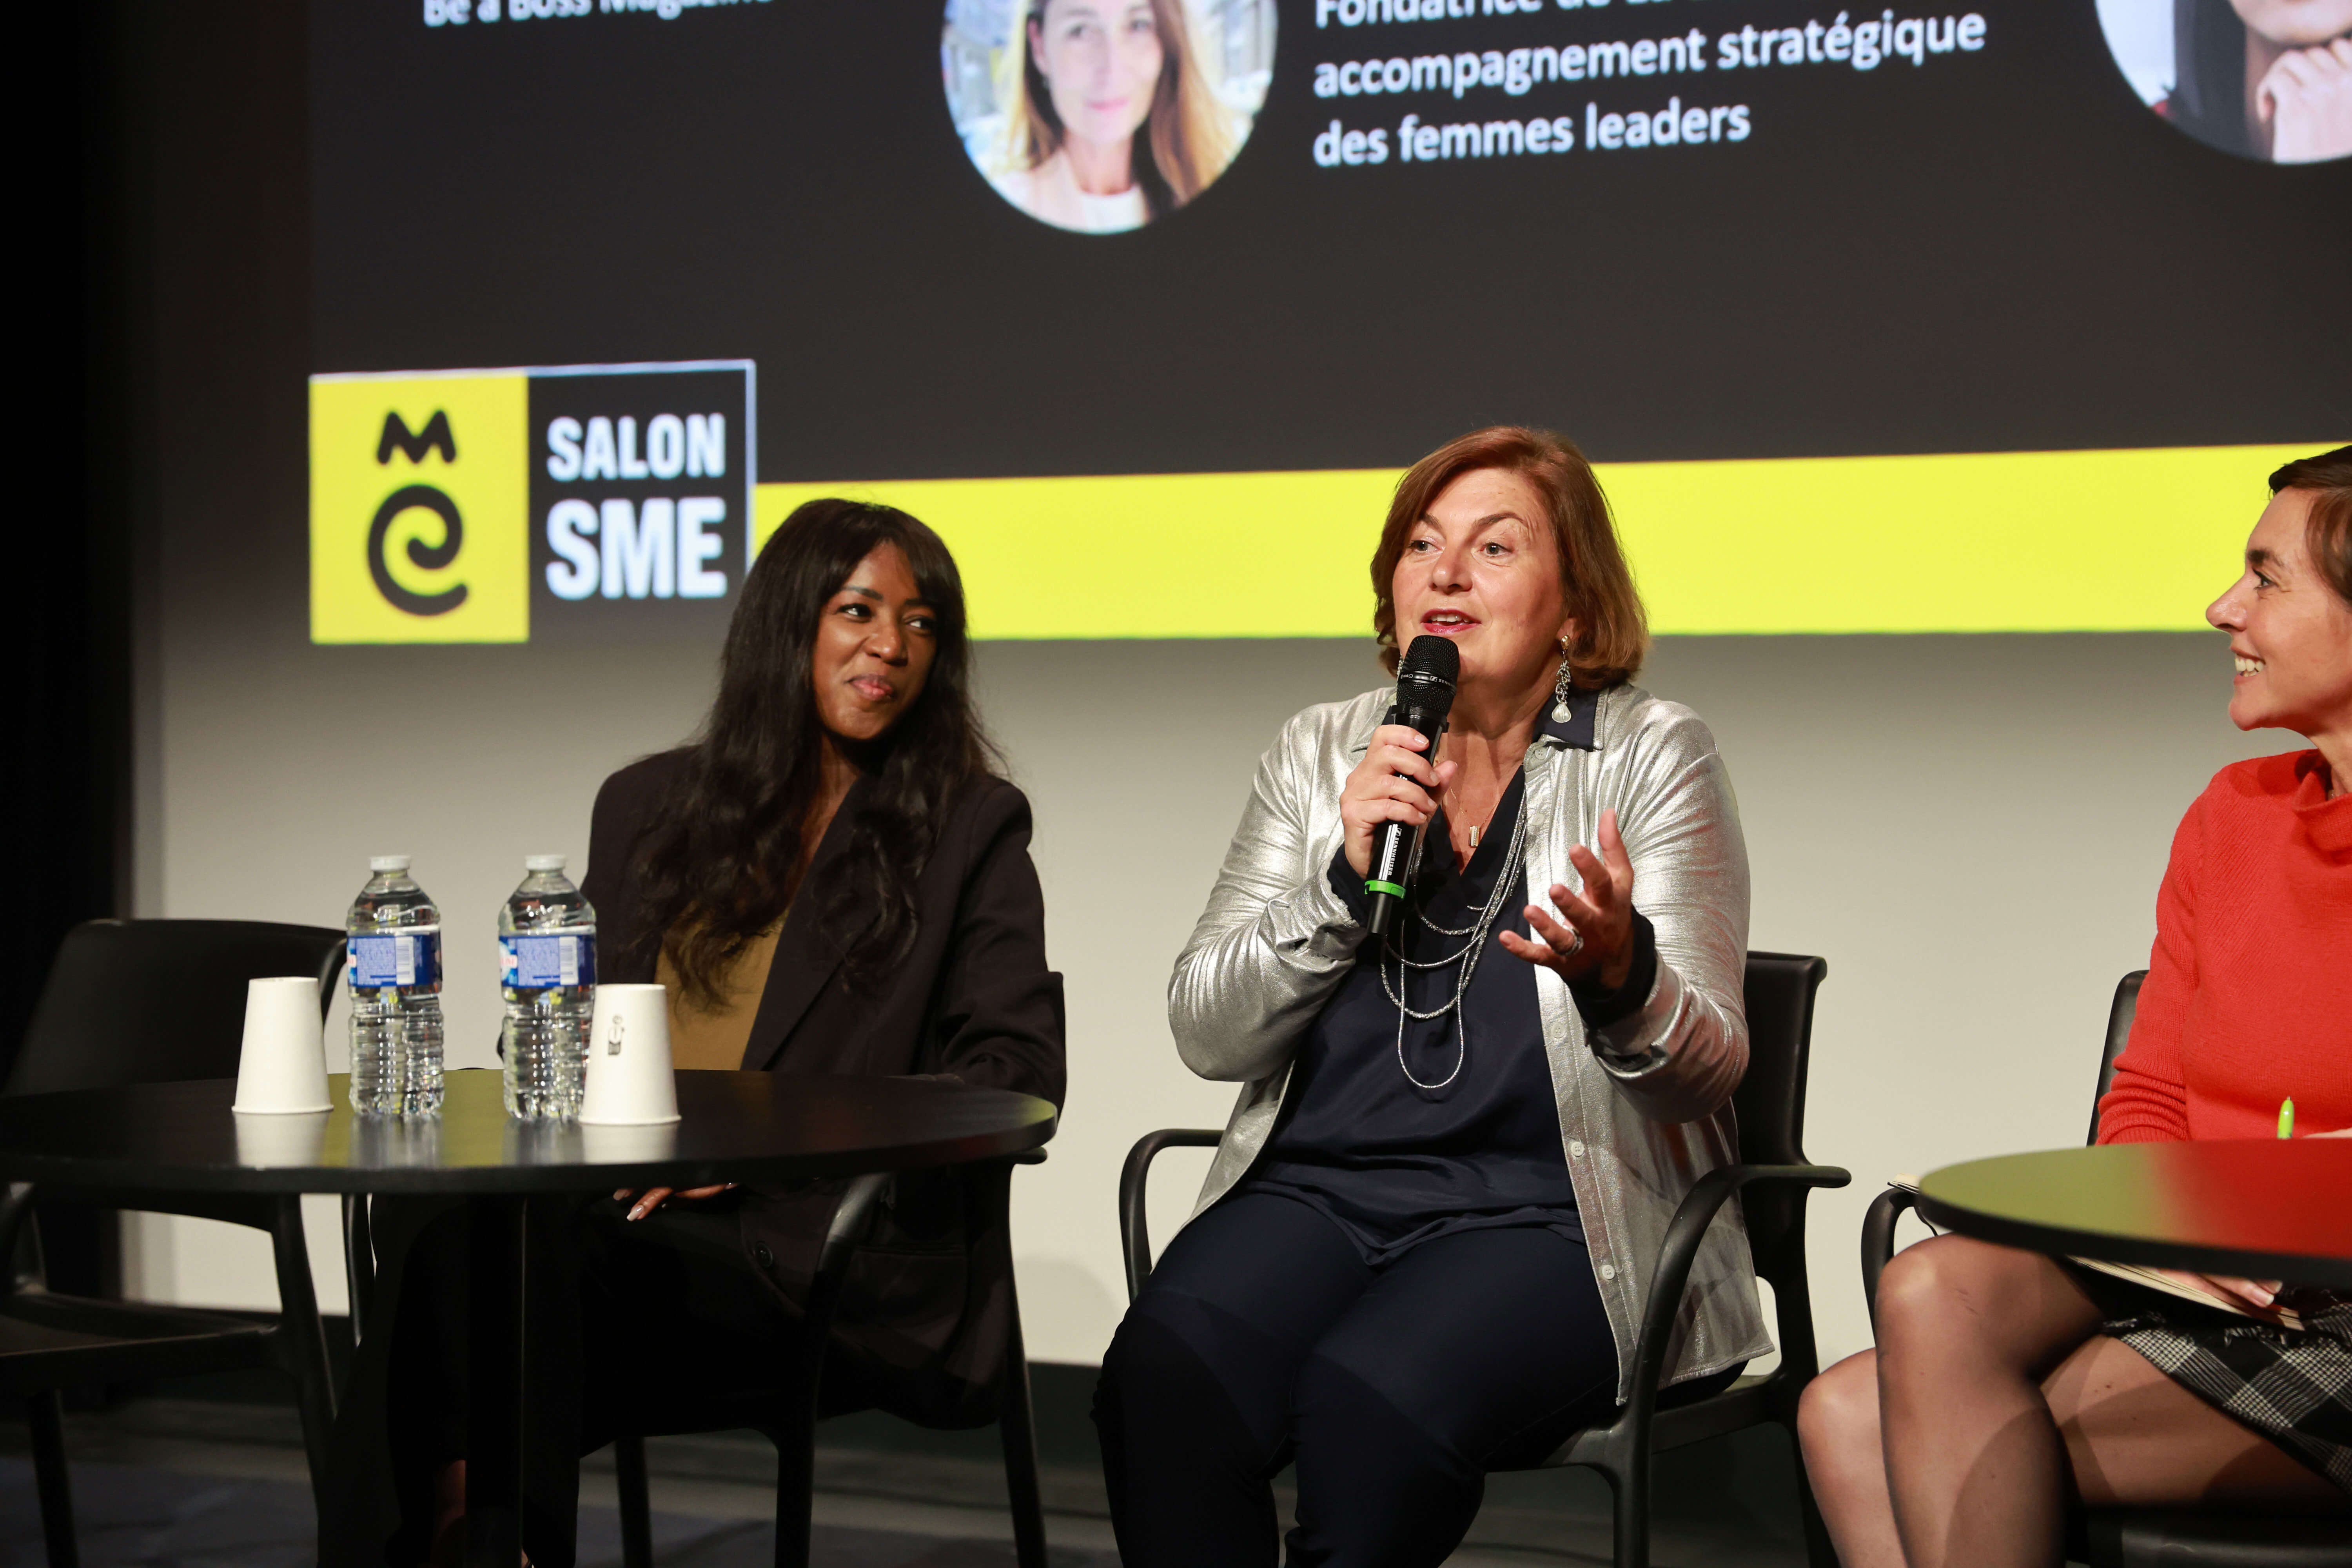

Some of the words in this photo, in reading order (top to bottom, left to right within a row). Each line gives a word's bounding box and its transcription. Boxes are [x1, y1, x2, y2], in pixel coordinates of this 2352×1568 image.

[1313, 28, 1707, 98] accompagnement
[1717, 9, 1987, 71] stratégique
[1313, 119, 1389, 167] des
[1397, 113, 1575, 162] femmes
[1585, 96, 1751, 150] leaders
[547, 413, 725, 481] SALON
[546, 497, 727, 600] SME
[1388, 837, 1399, 876] SENNHEISER
